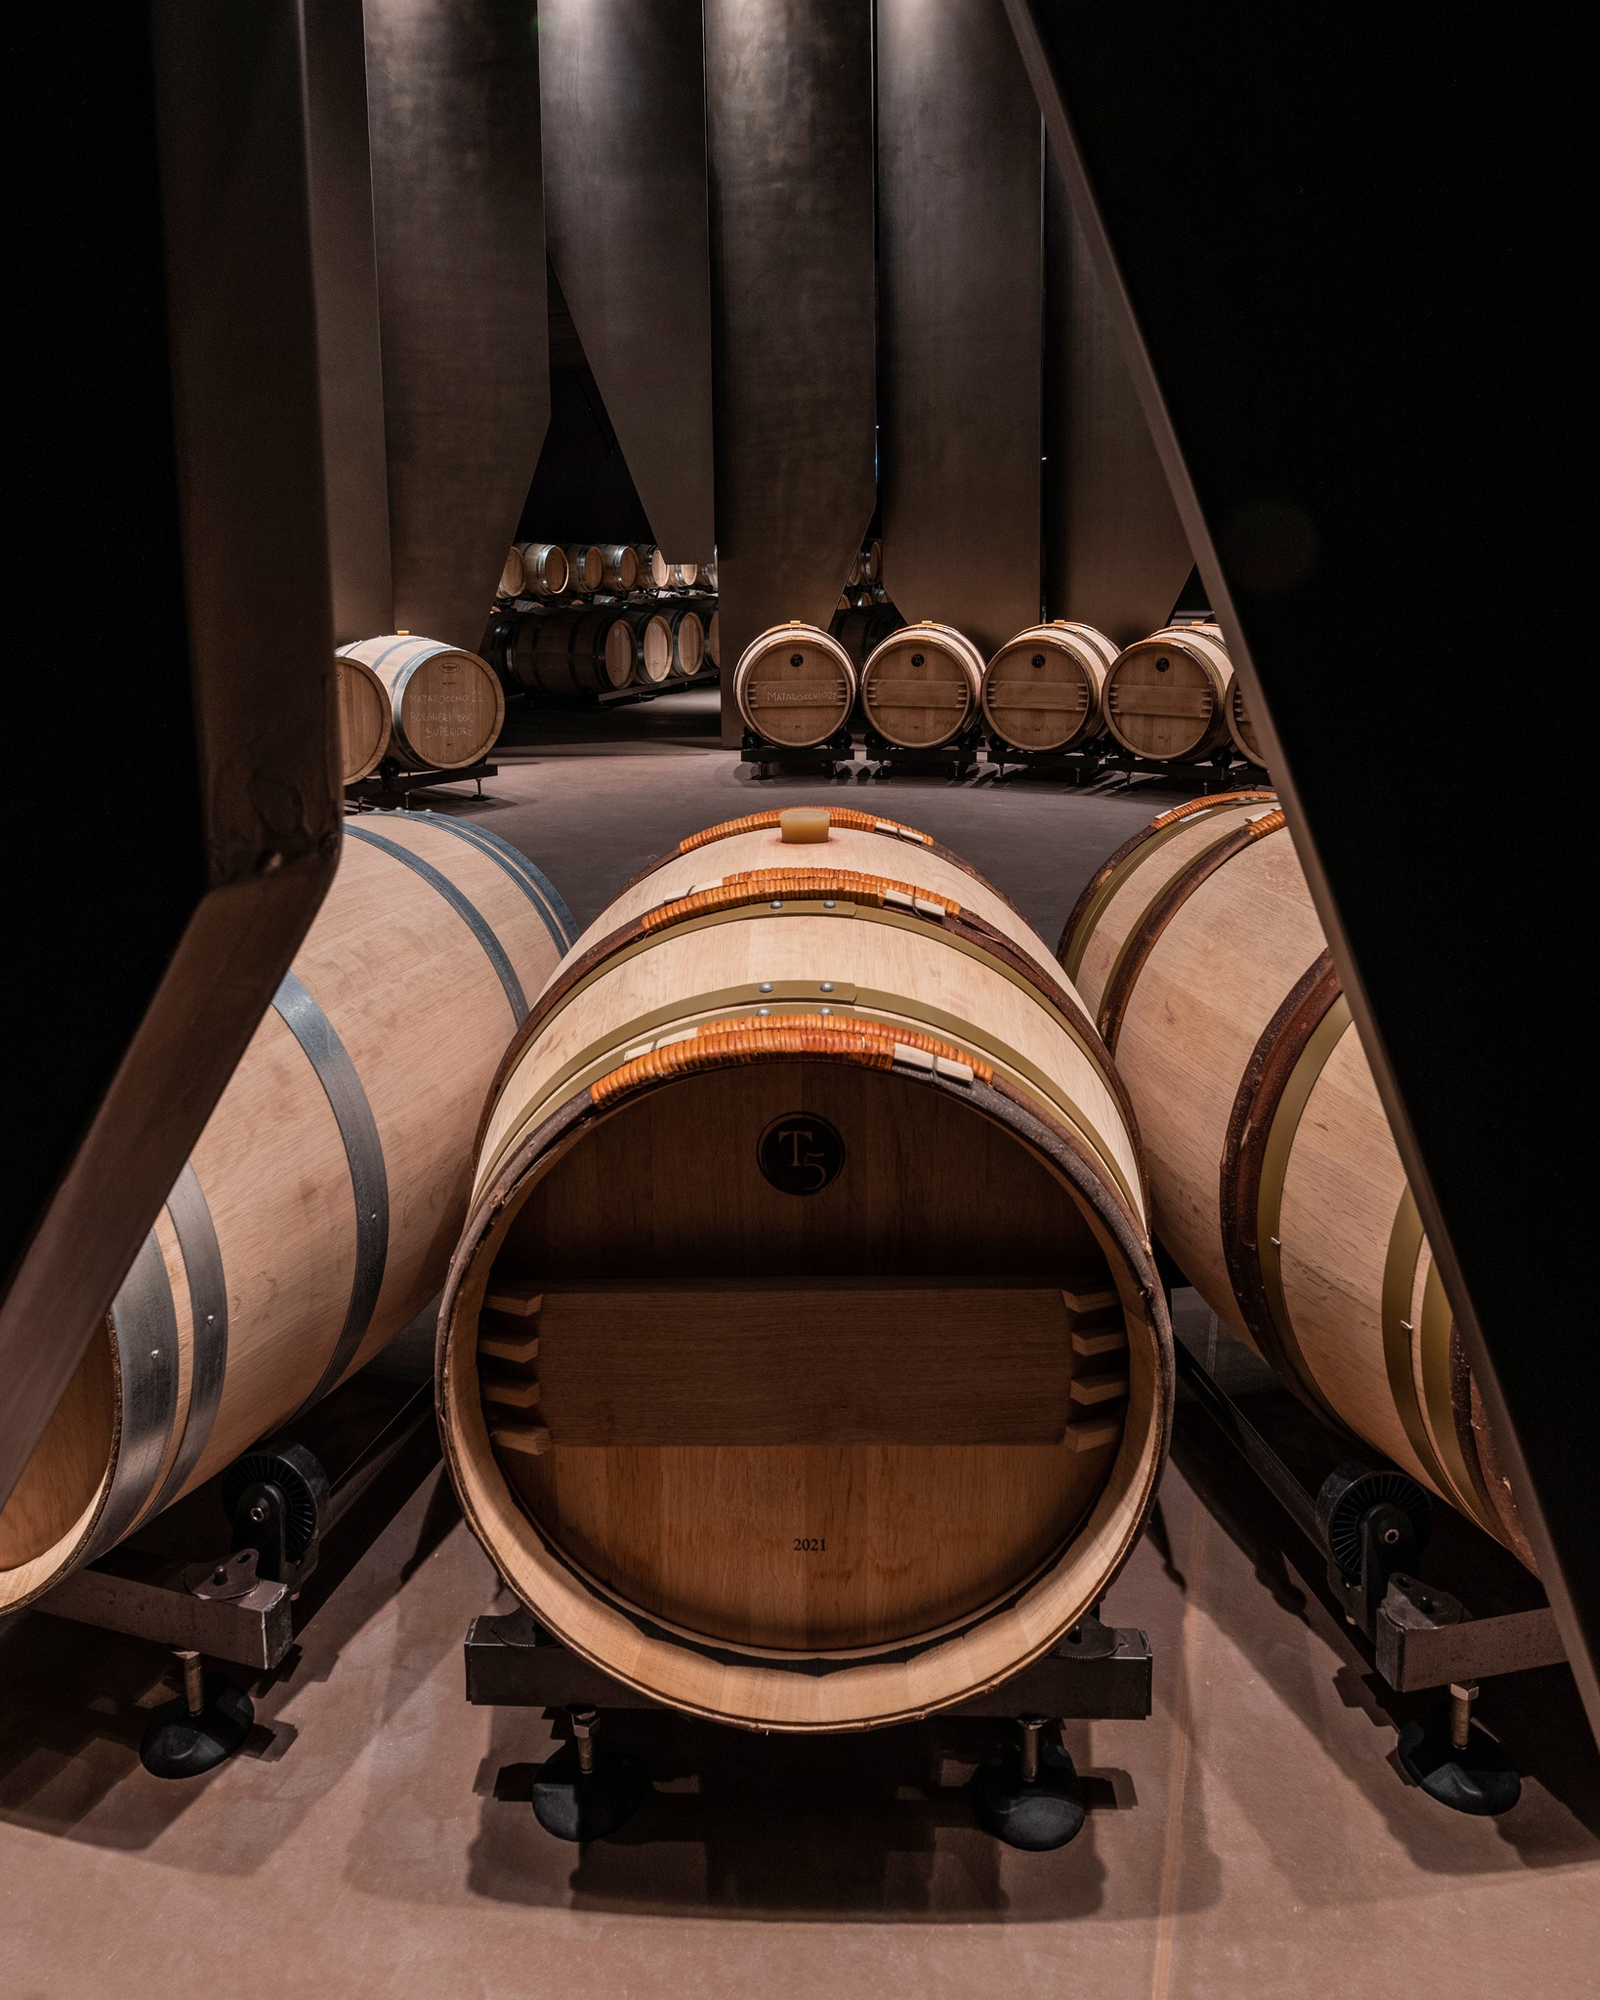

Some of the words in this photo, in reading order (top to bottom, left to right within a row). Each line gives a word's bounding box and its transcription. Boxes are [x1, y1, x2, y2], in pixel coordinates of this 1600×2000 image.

[409, 694, 469, 704] MATAROCCHIO
[471, 691, 484, 703] 22
[410, 712, 451, 724] BOLGHERI
[457, 713, 474, 723] DOC
[425, 726, 473, 738] SUPERIORE
[793, 1538, 826, 1552] 2021
